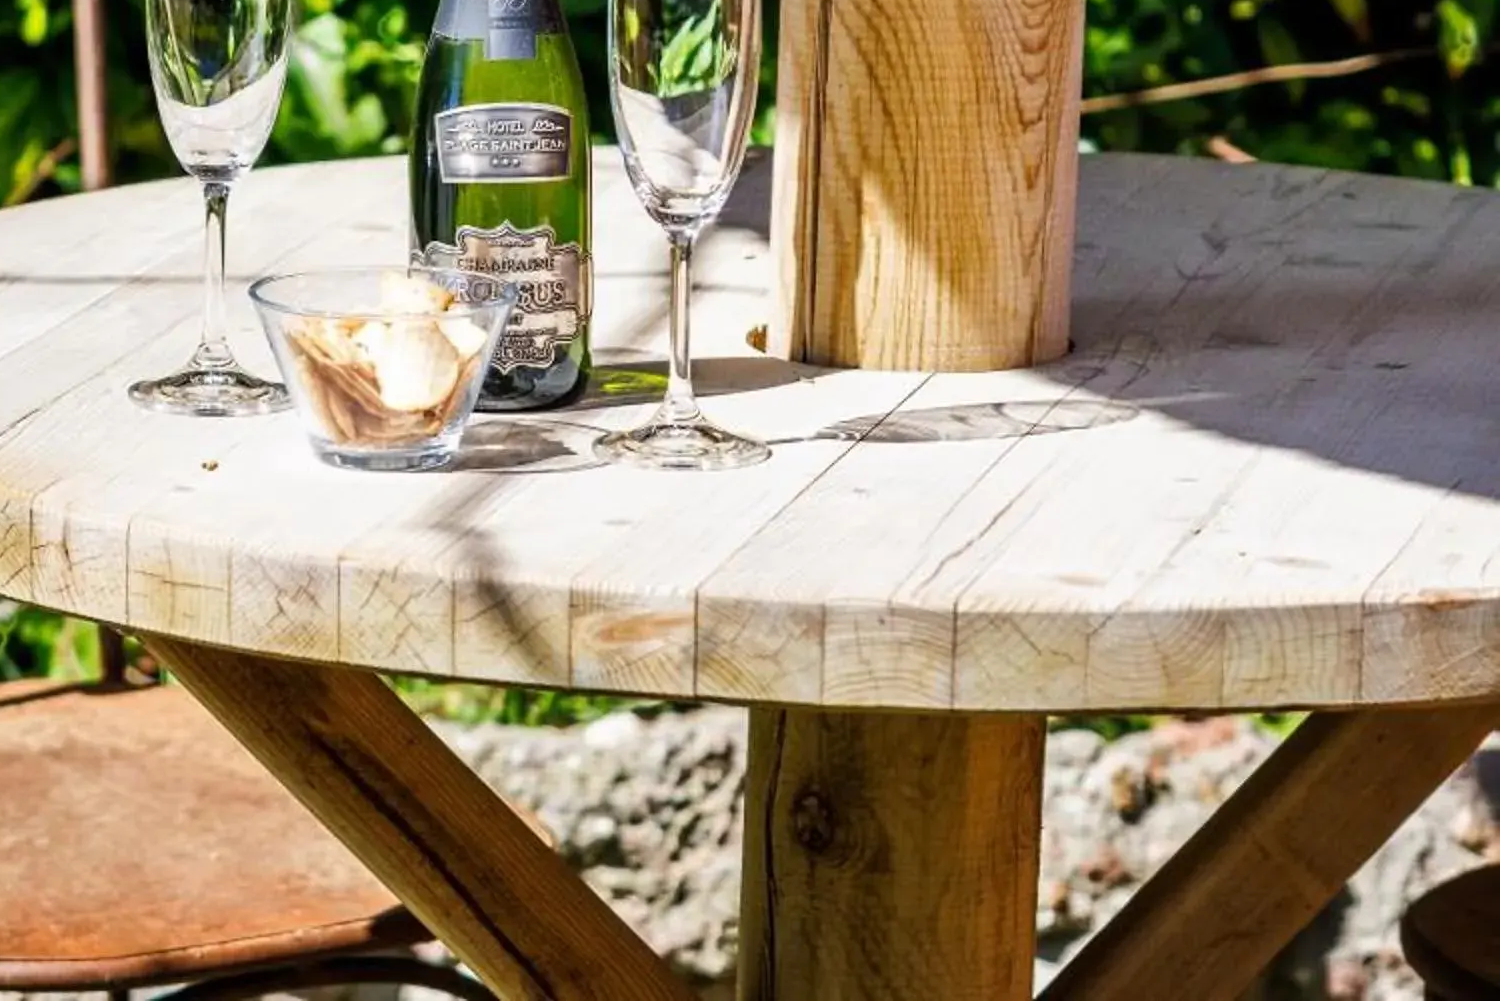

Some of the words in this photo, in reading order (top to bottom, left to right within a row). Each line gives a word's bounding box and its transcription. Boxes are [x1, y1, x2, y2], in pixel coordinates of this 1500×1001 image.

[486, 119, 526, 135] HOTEL
[490, 138, 533, 152] SAINT
[533, 137, 566, 152] JEAN
